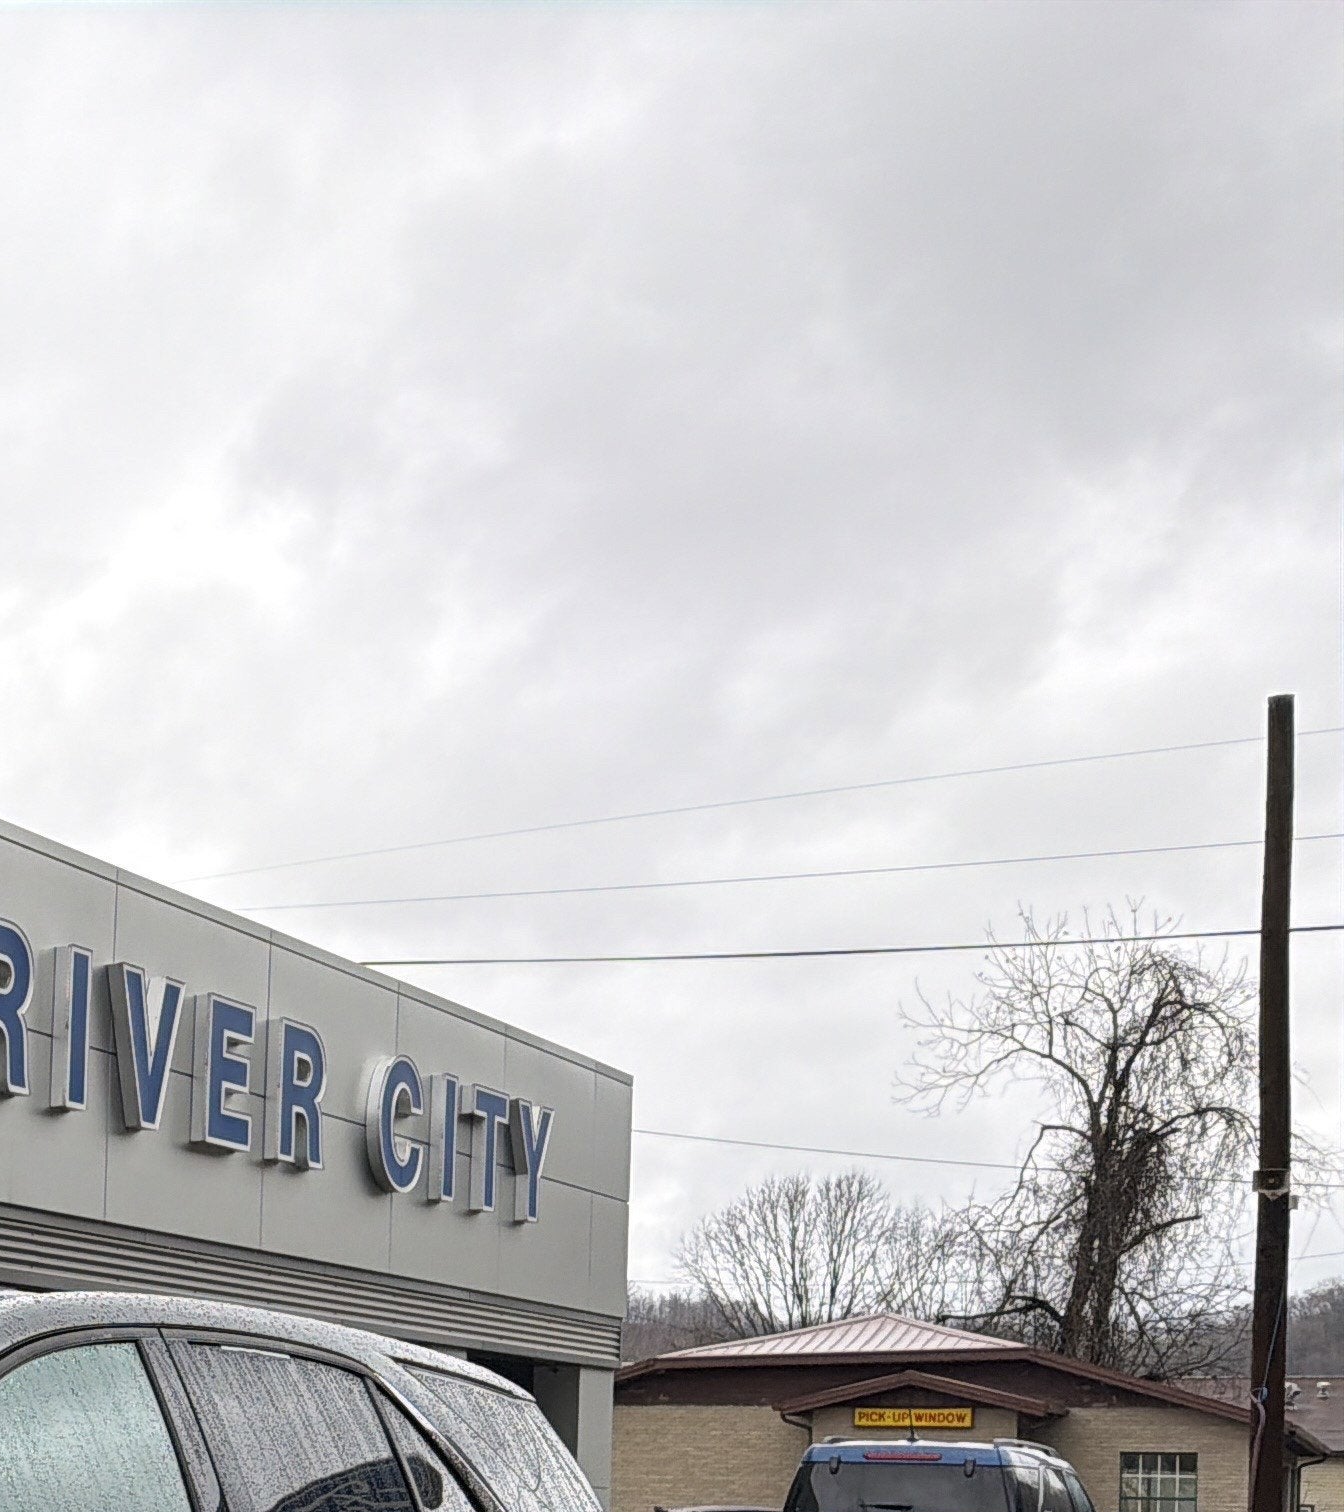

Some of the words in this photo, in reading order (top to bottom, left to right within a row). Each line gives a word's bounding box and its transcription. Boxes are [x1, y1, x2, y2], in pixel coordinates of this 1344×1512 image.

[366, 1054, 555, 1223] CITY
[857, 1411, 909, 1422] PICK-UP
[913, 1412, 966, 1423] WINDOW
